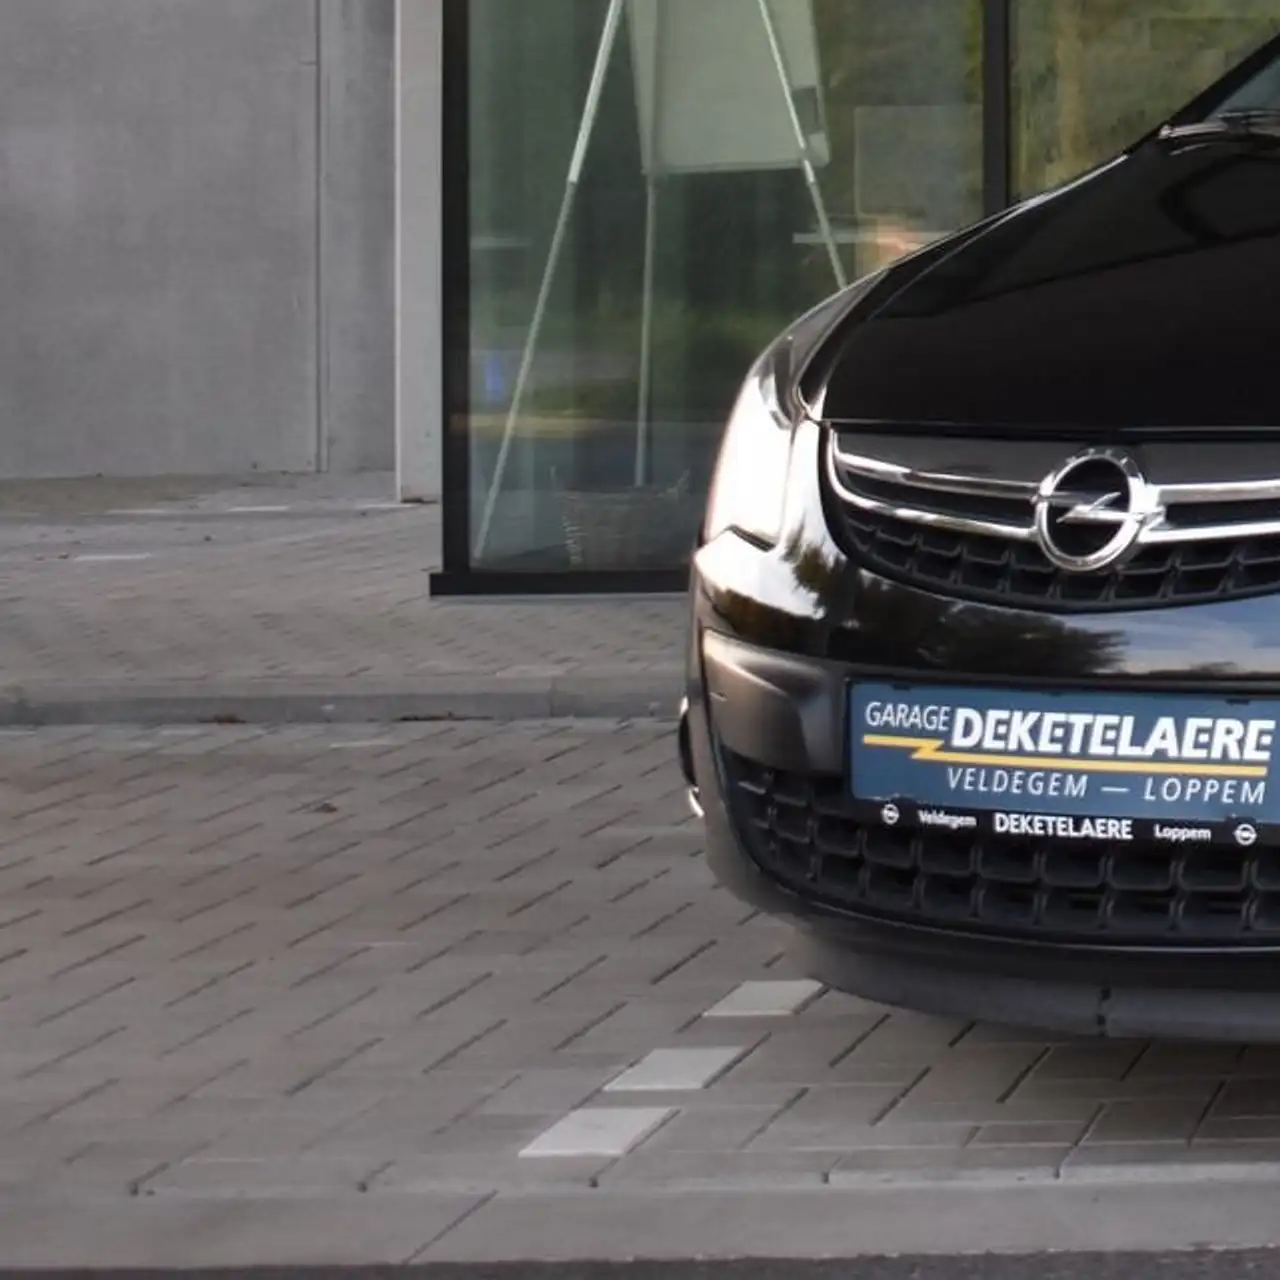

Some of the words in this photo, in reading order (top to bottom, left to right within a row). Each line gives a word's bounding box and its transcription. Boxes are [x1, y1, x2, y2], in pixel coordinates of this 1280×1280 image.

[866, 701, 951, 732] GARAGE
[951, 708, 1276, 761] DEKETELAERE
[948, 767, 1088, 798] VELDEGEM
[1143, 777, 1266, 805] LOPPEM
[917, 809, 977, 830] Veldegem
[994, 812, 1134, 840] DEKETELAERE
[1153, 824, 1211, 842] Loppem
